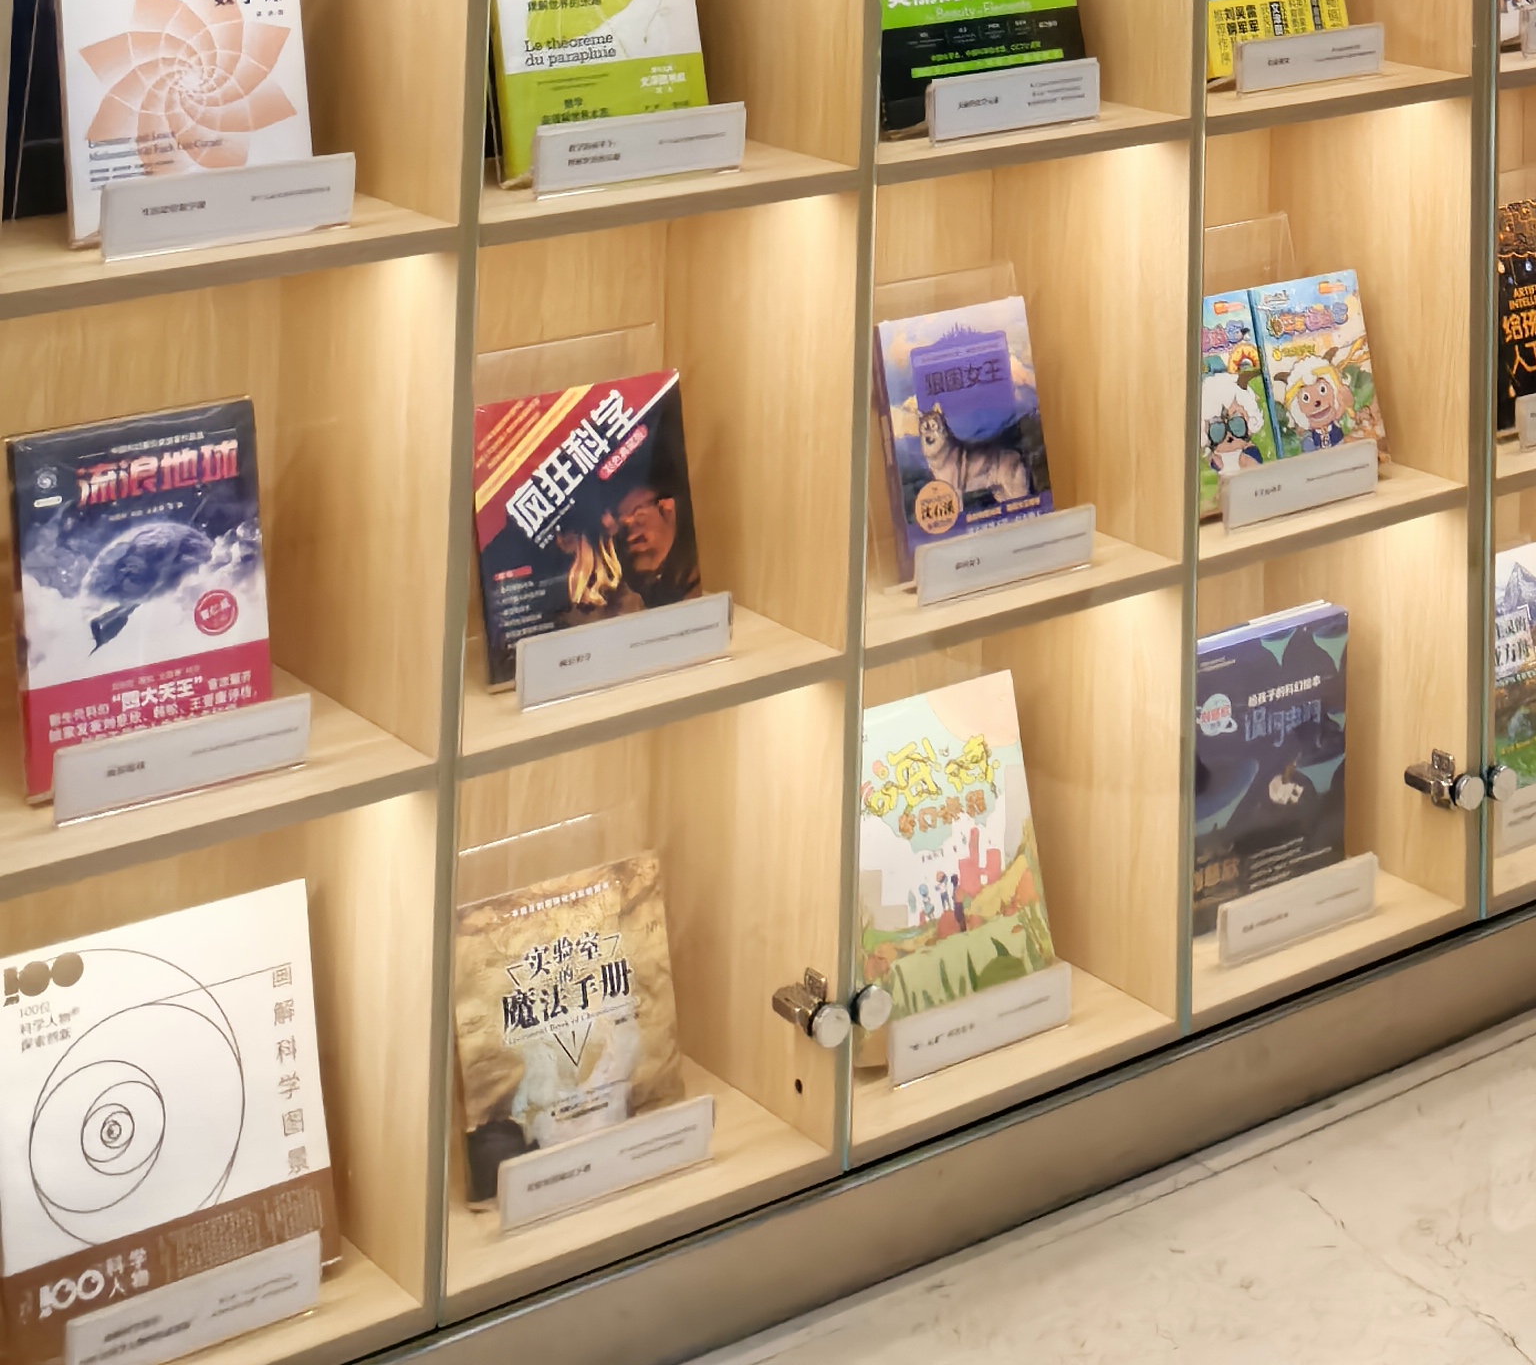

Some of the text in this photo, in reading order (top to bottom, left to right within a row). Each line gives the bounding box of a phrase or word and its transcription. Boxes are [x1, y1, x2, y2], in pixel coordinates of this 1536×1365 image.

[524, 38, 543, 54] Le
[525, 46, 616, 68] du parapluie
[925, 358, 1007, 396] 狼国女王
[76, 438, 239, 507] 流浪地球
[506, 389, 635, 539] 疯狂科学
[524, 931, 603, 980] 实验室
[502, 958, 632, 1032] 魔法手册
